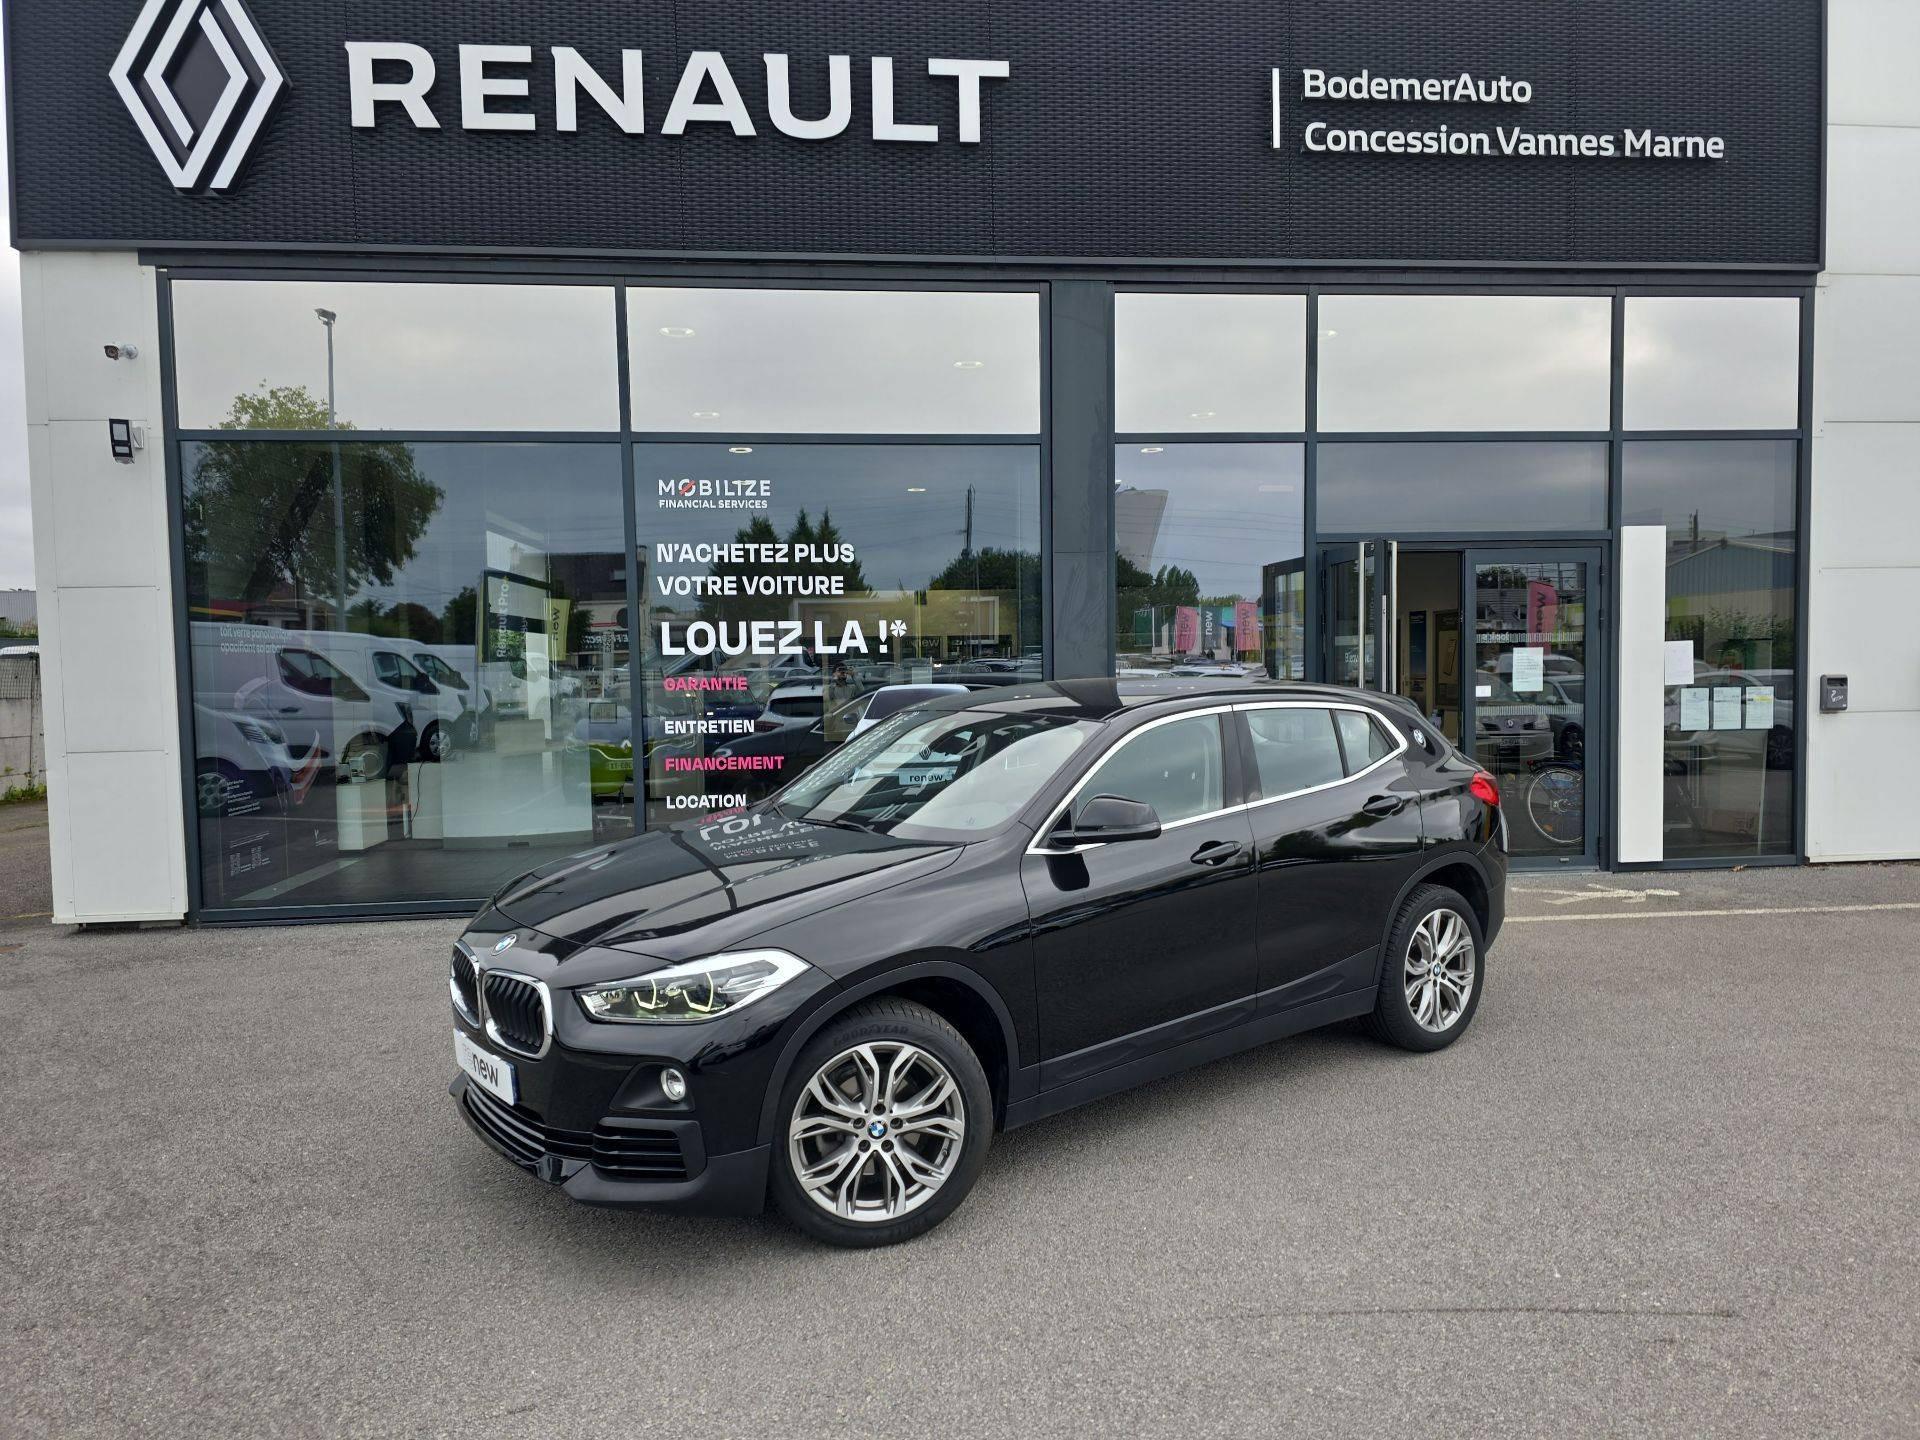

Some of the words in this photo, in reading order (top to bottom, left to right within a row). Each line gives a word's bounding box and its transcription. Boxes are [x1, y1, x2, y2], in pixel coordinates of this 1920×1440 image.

[344, 41, 1010, 143] RENAULT
[1302, 68, 1532, 103] BodemerAuto
[1304, 121, 1491, 155] Concession
[1496, 126, 1615, 157] Vannes
[1623, 128, 1725, 159] Marne
[658, 499, 717, 509] FINANCIAL
[718, 499, 768, 509] SERVICES
[656, 543, 789, 563] N'ACHETEZ
[794, 543, 855, 563] PLUS
[656, 575, 738, 596] VOTRE
[741, 575, 844, 596] VOITURE
[1205, 611, 1214, 636] new
[661, 620, 803, 656] LOUEZ
[814, 620, 869, 655] LA
[664, 676, 748, 692] GARANTIE
[664, 719, 755, 735] ENTRETIEN
[665, 756, 784, 771] FINANCEMENT
[666, 793, 747, 809] LOCATION
